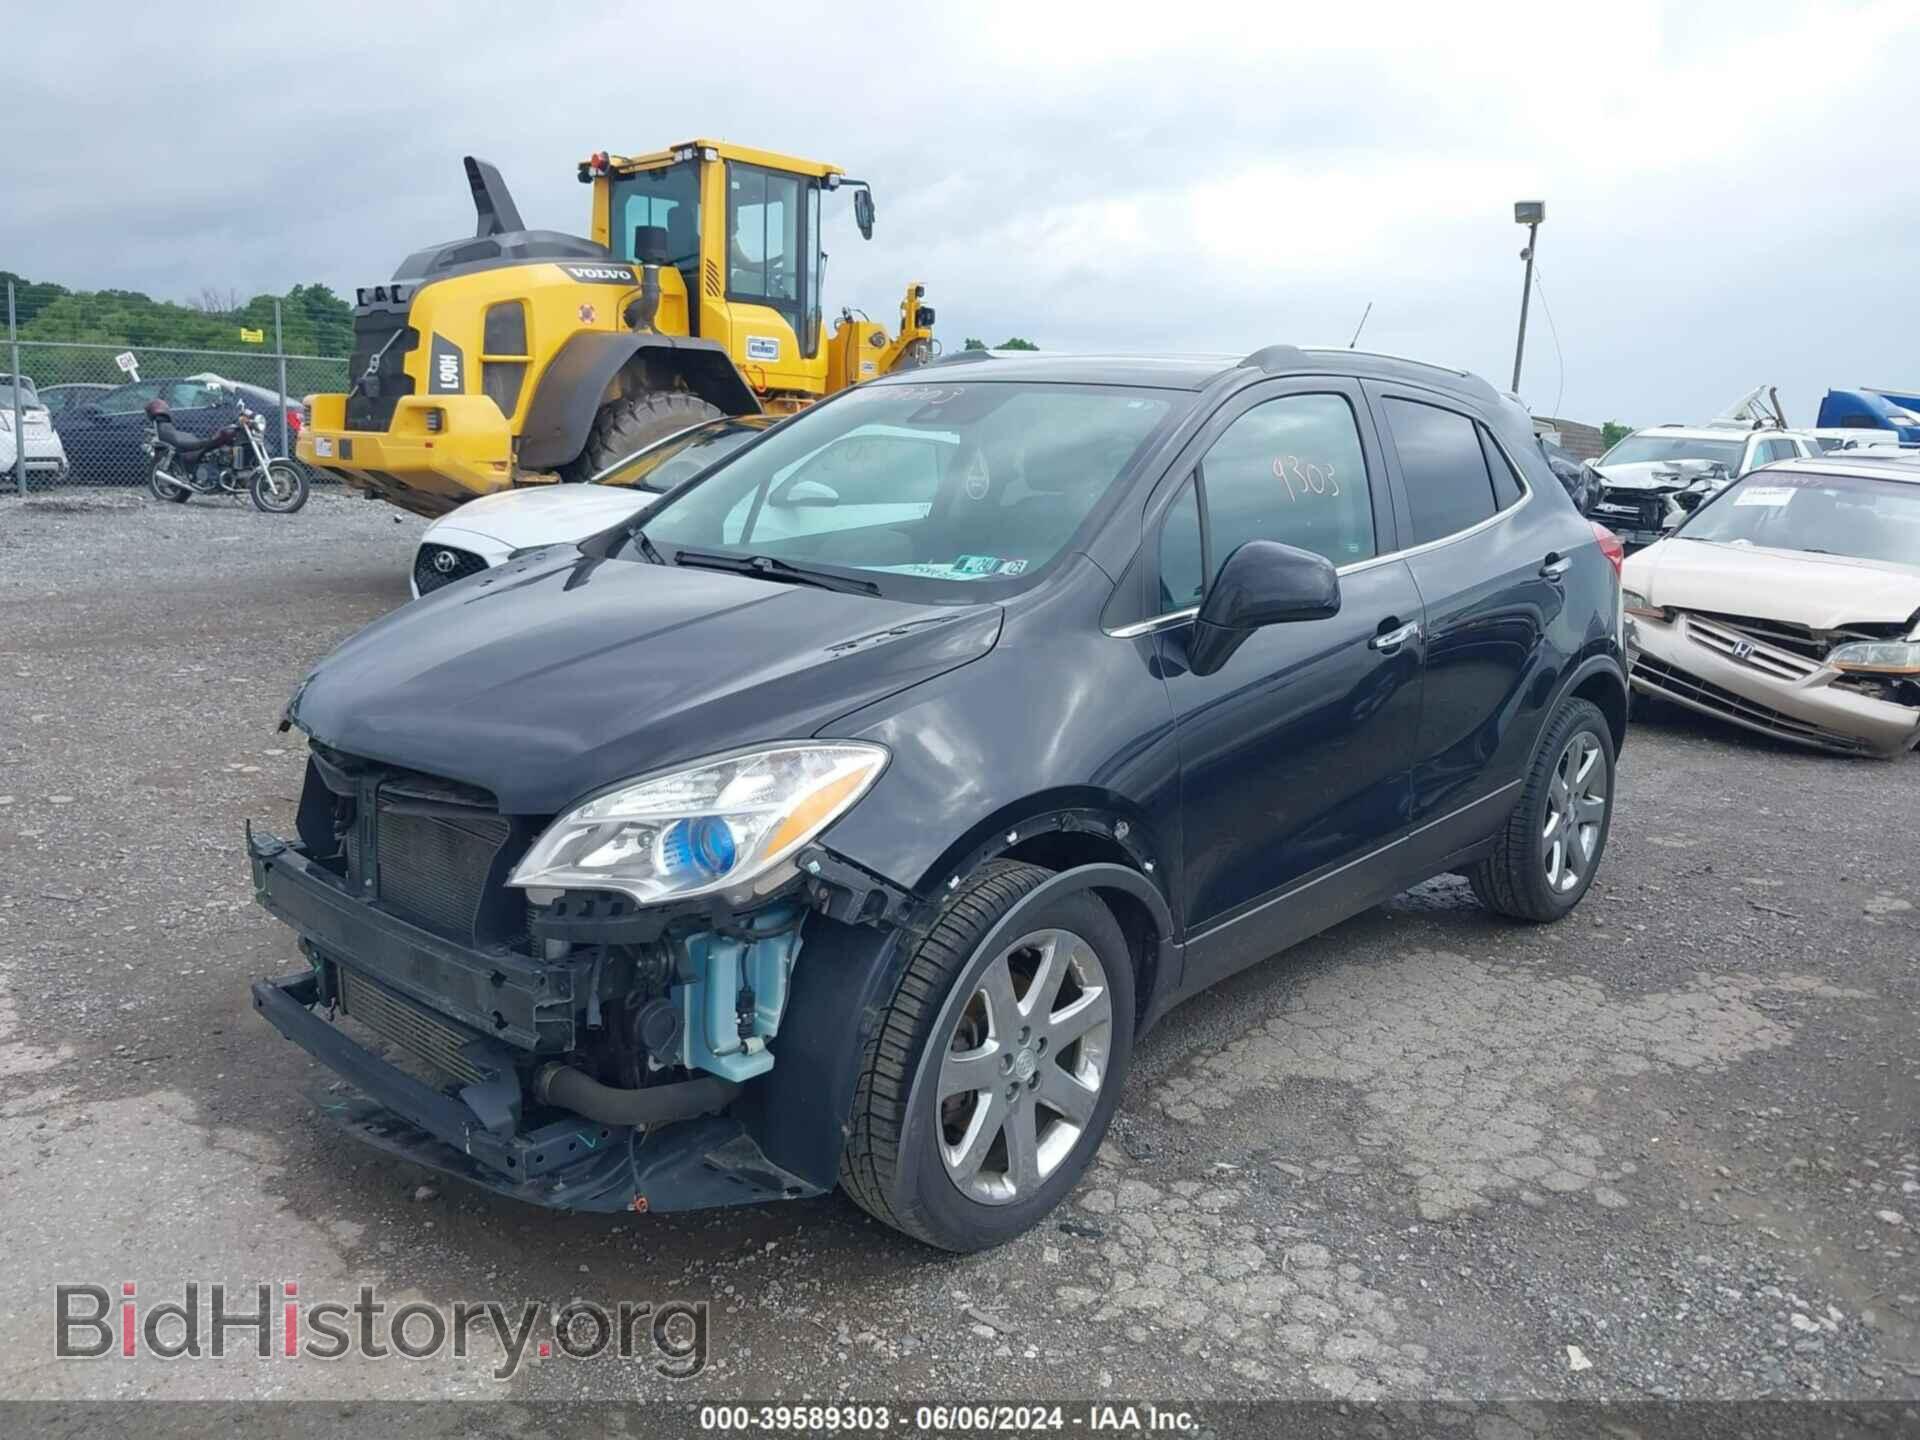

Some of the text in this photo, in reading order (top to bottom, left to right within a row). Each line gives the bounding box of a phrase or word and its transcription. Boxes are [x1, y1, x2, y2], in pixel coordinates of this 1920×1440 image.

[568, 267, 632, 280] VOLVO
[439, 354, 459, 389] L90H
[1272, 455, 1340, 502] 9303
